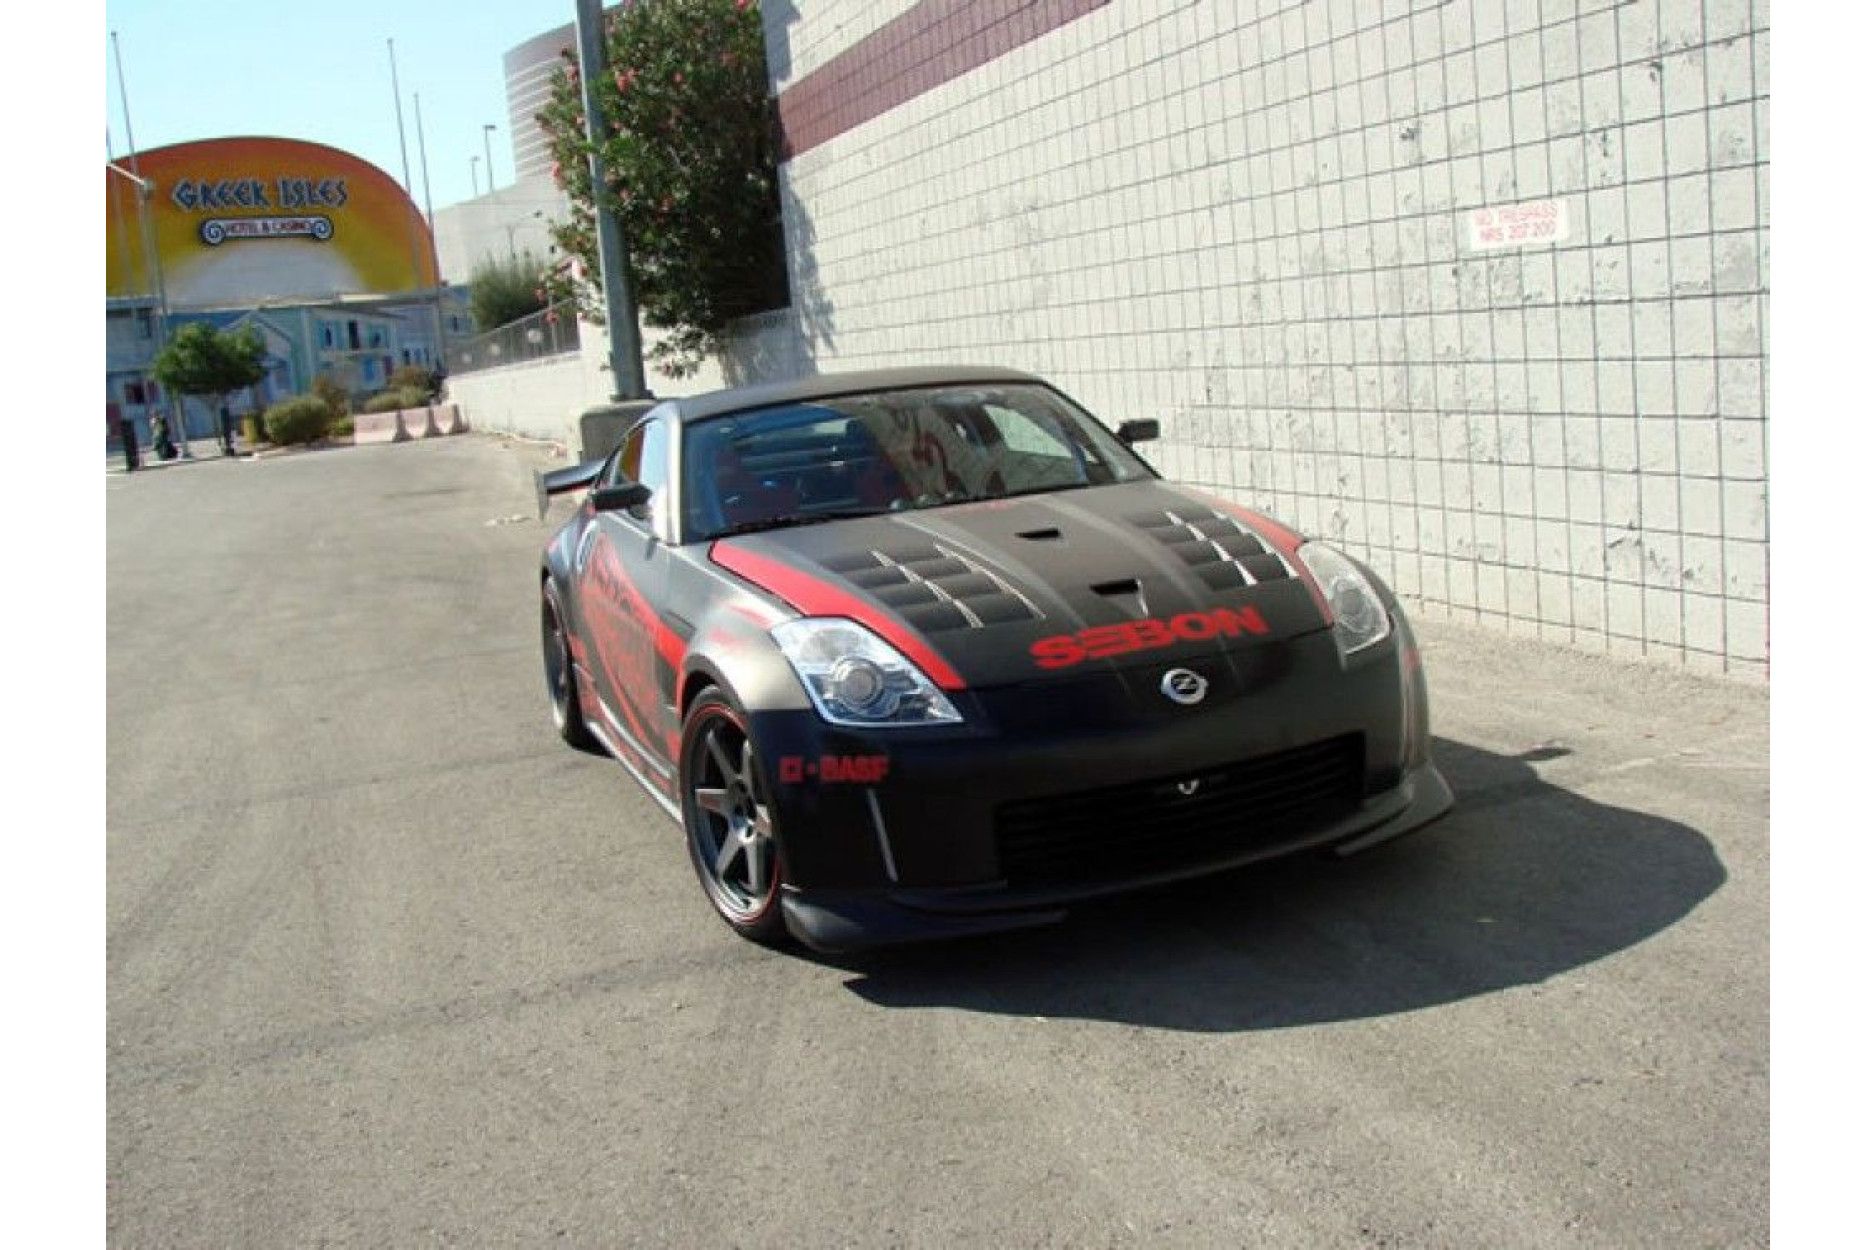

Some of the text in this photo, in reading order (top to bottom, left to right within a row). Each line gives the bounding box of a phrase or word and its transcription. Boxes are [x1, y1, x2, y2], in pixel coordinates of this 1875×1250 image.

[172, 177, 347, 209] GREEK ISLES
[1030, 604, 1270, 671] SEBON
[820, 755, 889, 784] BASF
